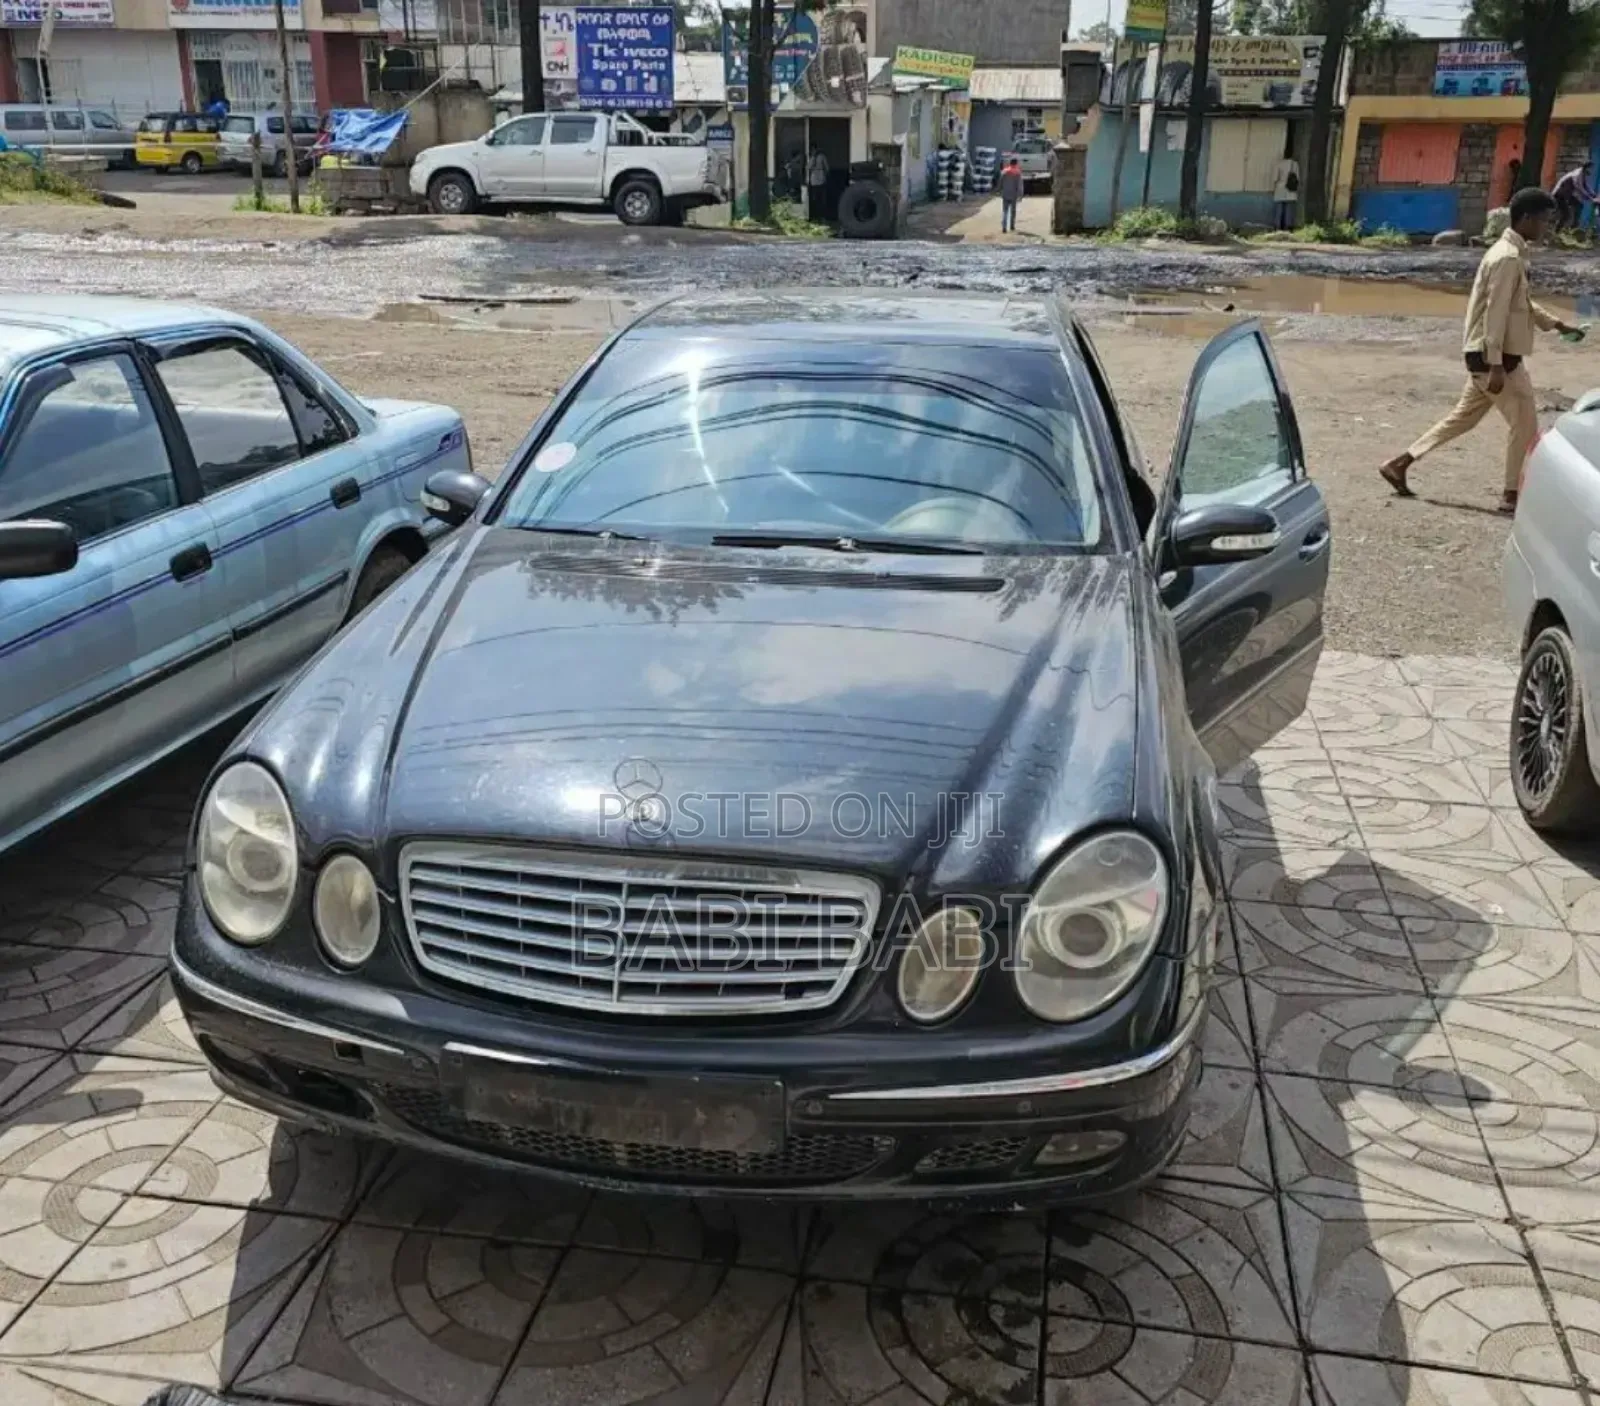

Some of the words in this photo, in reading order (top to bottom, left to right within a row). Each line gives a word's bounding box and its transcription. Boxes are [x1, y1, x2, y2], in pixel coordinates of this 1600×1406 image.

[898, 48, 973, 67] KADISCO
[592, 60, 629, 72] Spare
[632, 60, 666, 71] Parts
